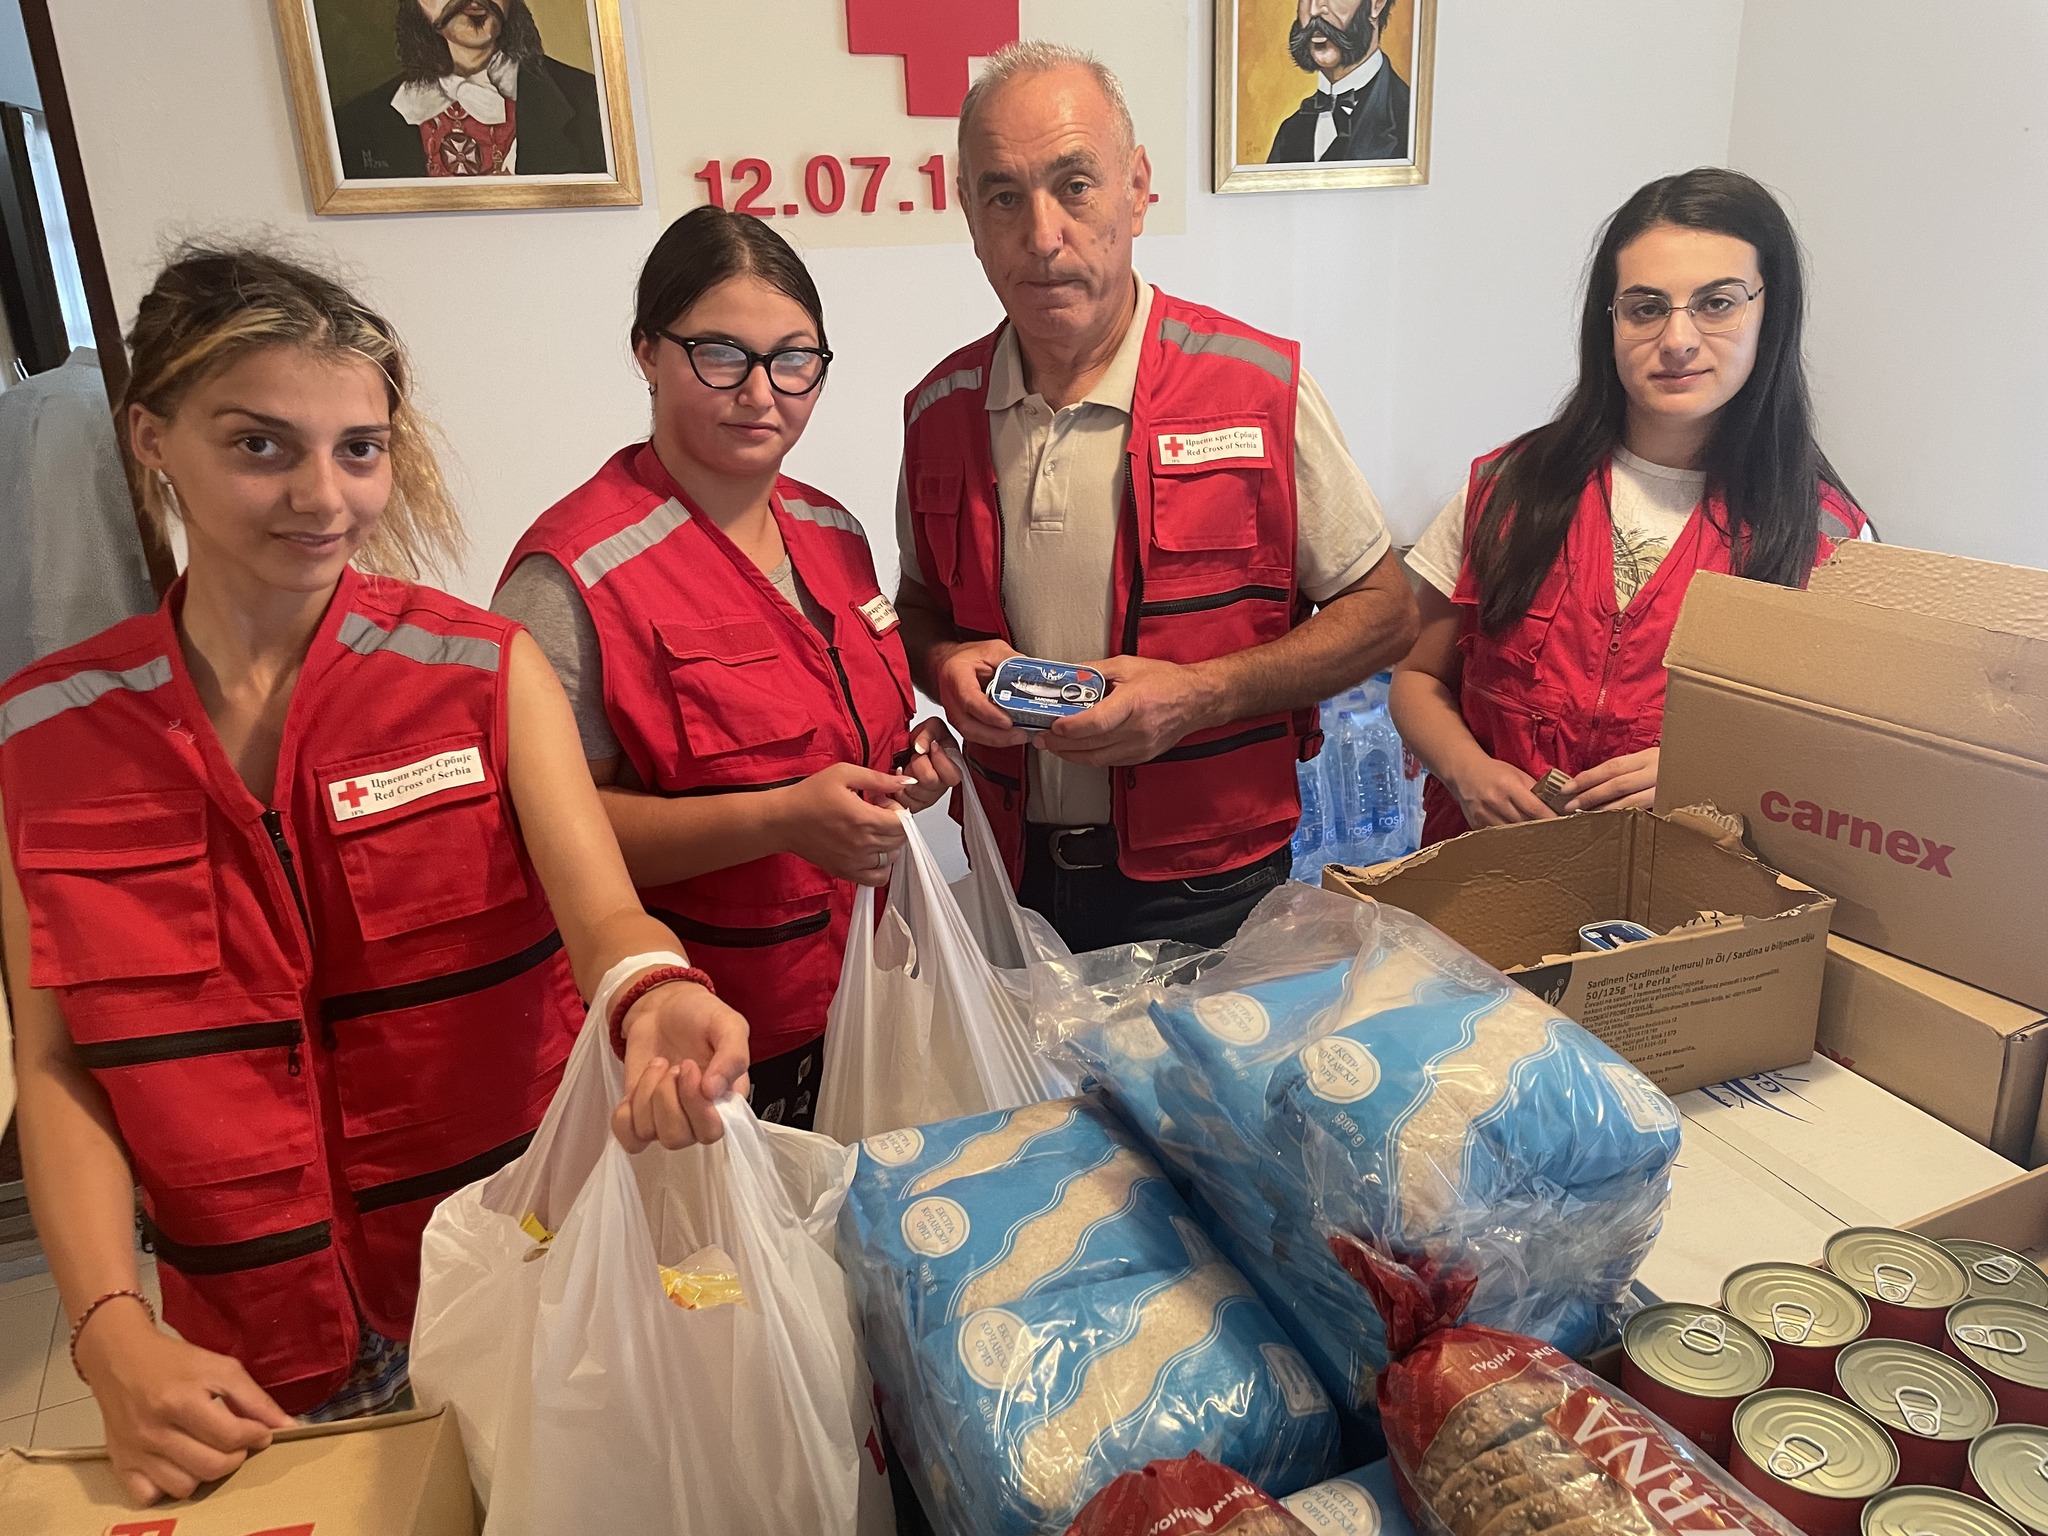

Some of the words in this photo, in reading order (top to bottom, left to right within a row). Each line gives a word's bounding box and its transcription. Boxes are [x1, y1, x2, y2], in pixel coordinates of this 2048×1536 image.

[1202, 445, 1224, 454] Cross
[371, 772, 410, 788] Црвени
[412, 764, 434, 778] крст
[436, 754, 472, 768] Србије
[374, 791, 395, 801] Red
[397, 781, 424, 795] Cross
[426, 774, 436, 784] of
[438, 766, 472, 780] Serbia
[1348, 822, 1373, 836] rosa
[1379, 814, 1405, 826] rosa
[1760, 790, 1956, 878] carnex
[1587, 976, 1624, 989] Sardinen
[1733, 947, 1763, 960] Sardina
[1586, 986, 1626, 1000] 50/125g
[1330, 1043, 1360, 1072] ЕКСТР
[1335, 1111, 1358, 1136] 900
[1351, 1133, 1366, 1148] g
[975, 1340, 993, 1367] ОРИЗ
[1302, 1500, 1330, 1526] ОРИЗ
[1321, 1485, 1358, 1517] ЕКСТРА
